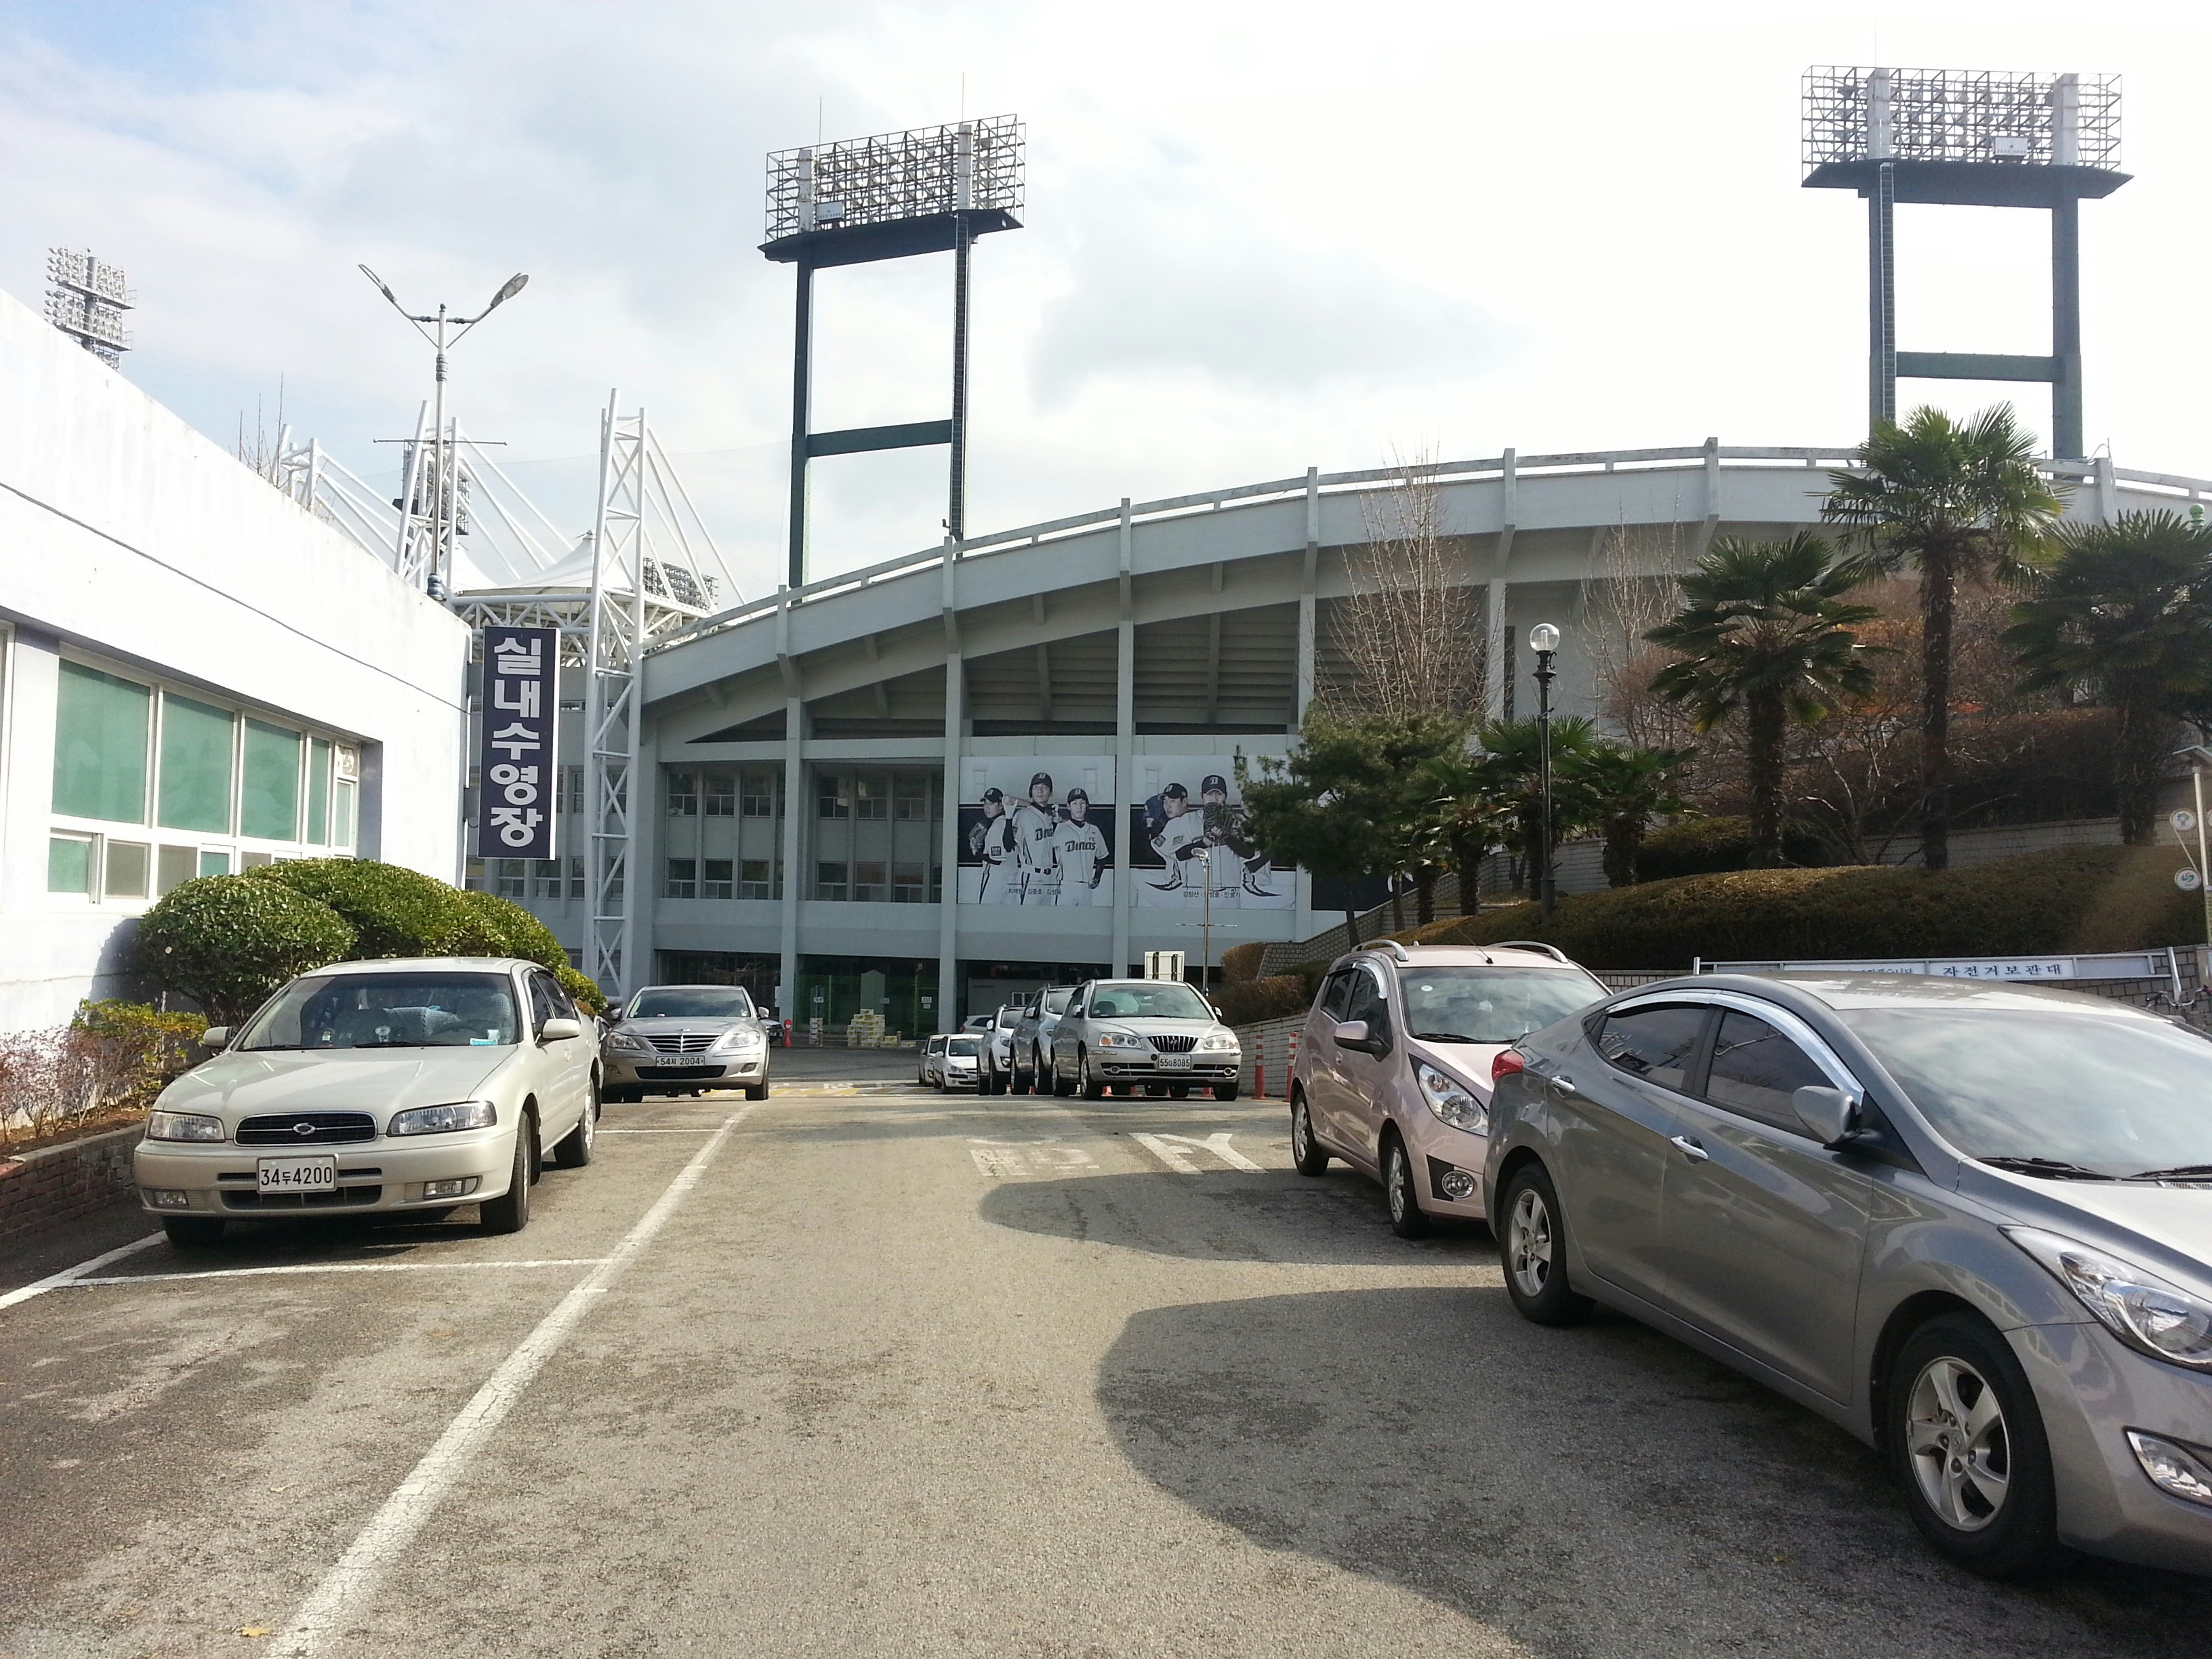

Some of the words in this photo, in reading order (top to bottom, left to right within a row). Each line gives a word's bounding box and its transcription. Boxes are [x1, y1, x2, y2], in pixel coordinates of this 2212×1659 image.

[489, 637, 544, 847] 실내수영장
[1065, 840, 1096, 852] Dinos
[1943, 964, 2062, 977] 자전거보관대
[680, 1057, 700, 1065] 2004
[261, 1166, 332, 1186] 34두4200
